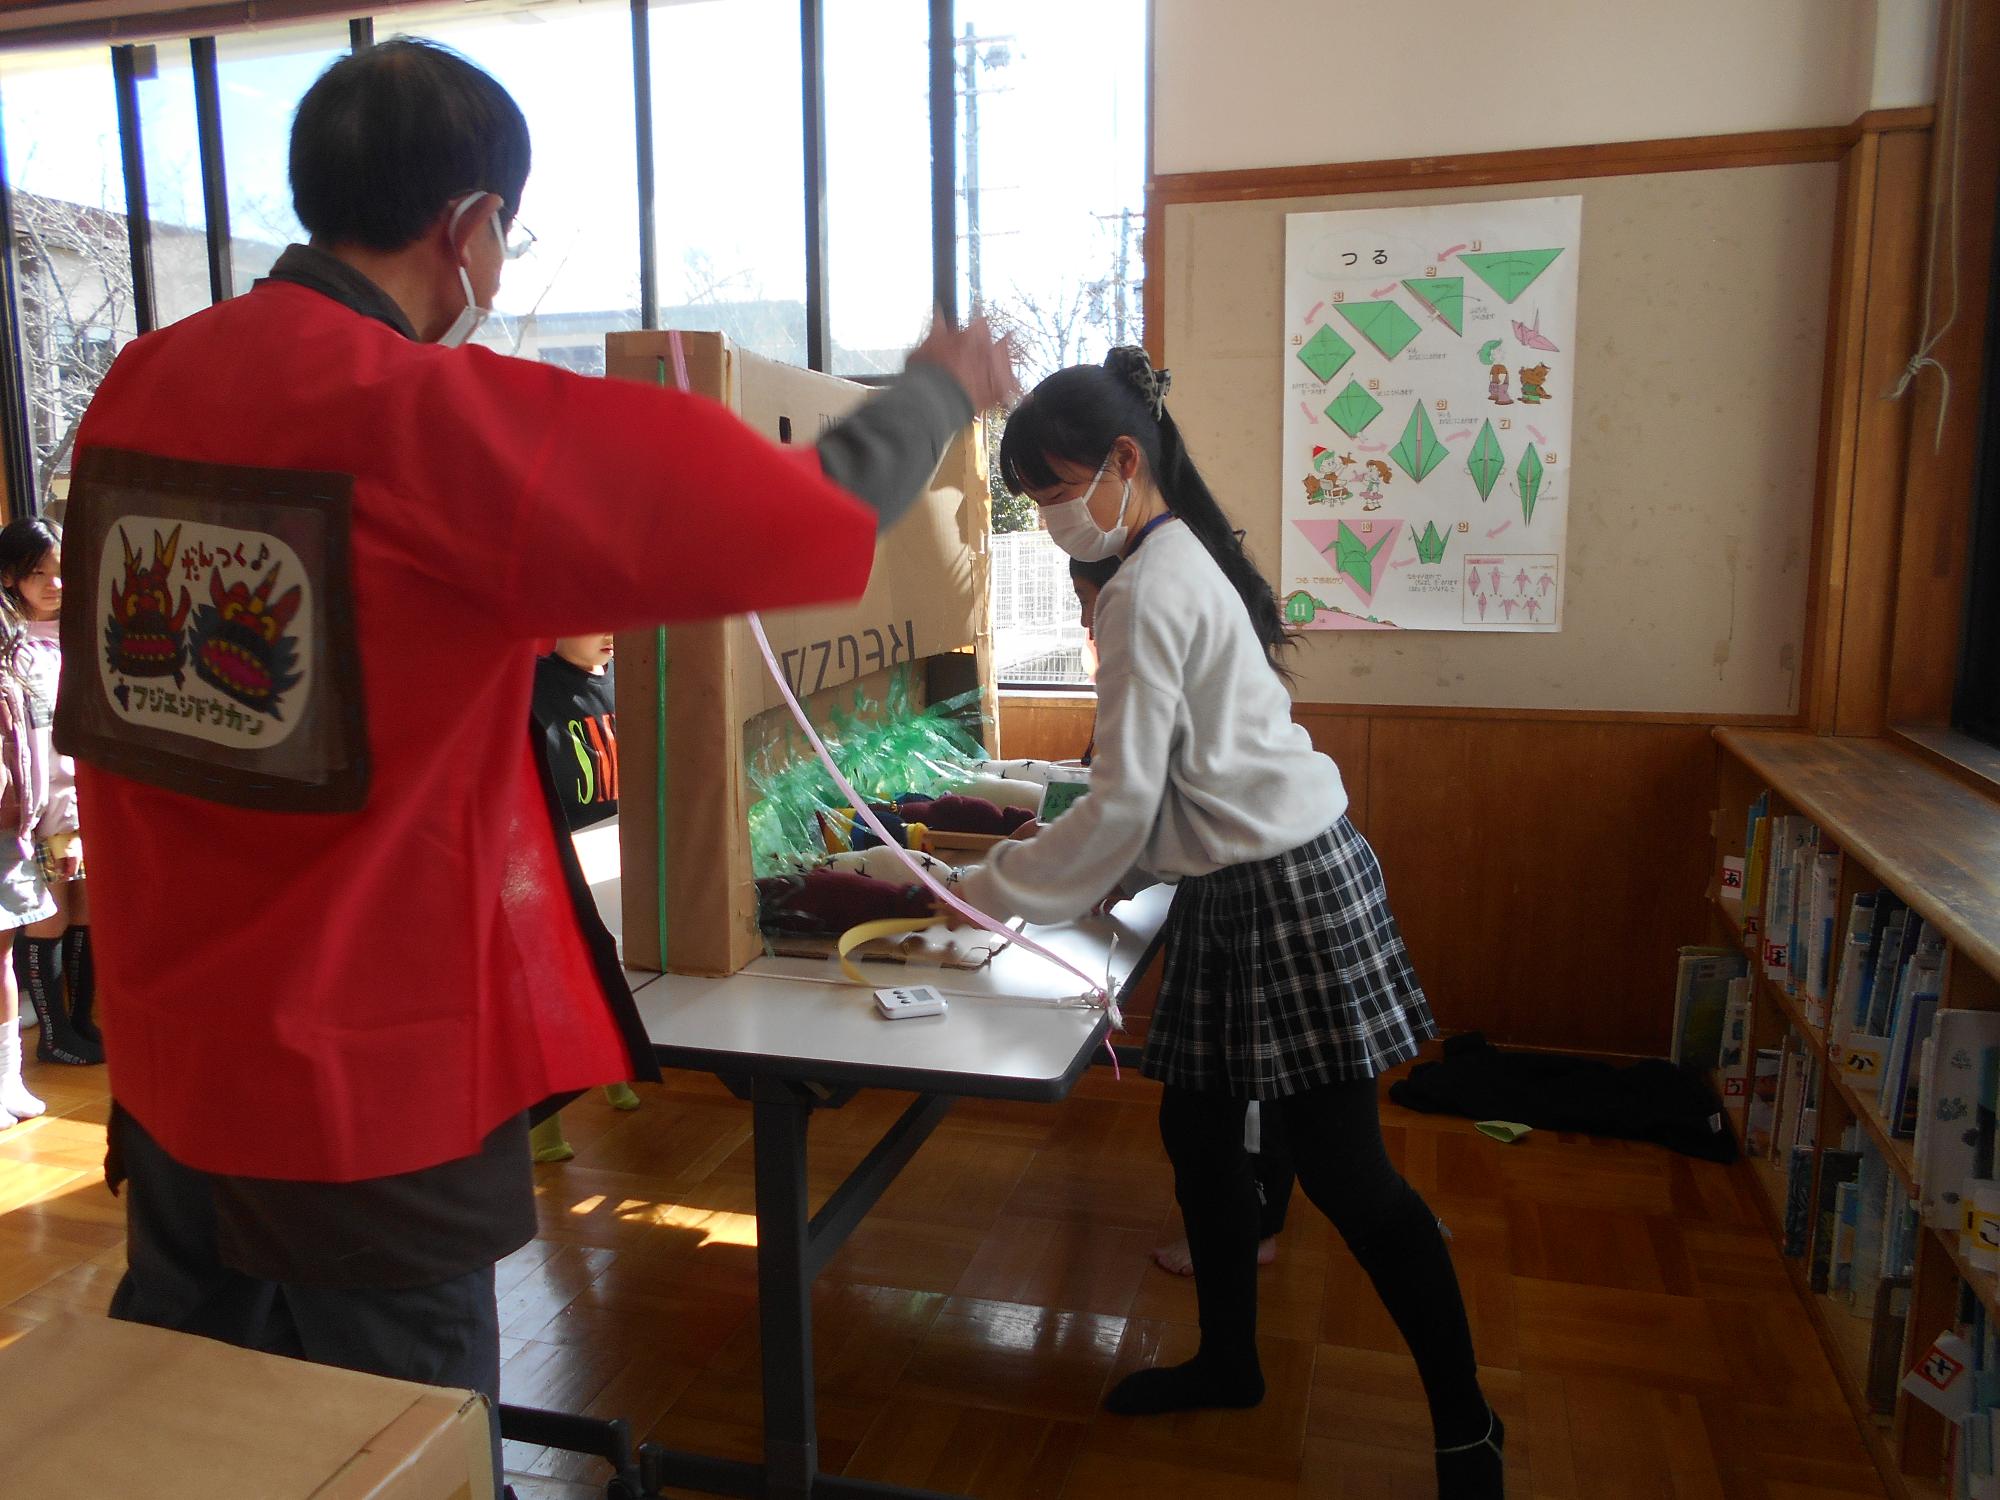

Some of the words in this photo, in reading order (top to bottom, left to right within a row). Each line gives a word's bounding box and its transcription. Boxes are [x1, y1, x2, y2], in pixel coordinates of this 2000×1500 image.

[1341, 248, 1389, 266] つる
[1293, 602, 1306, 616] 11
[1725, 871, 1739, 886] あ
[1730, 1080, 1740, 1094] う
